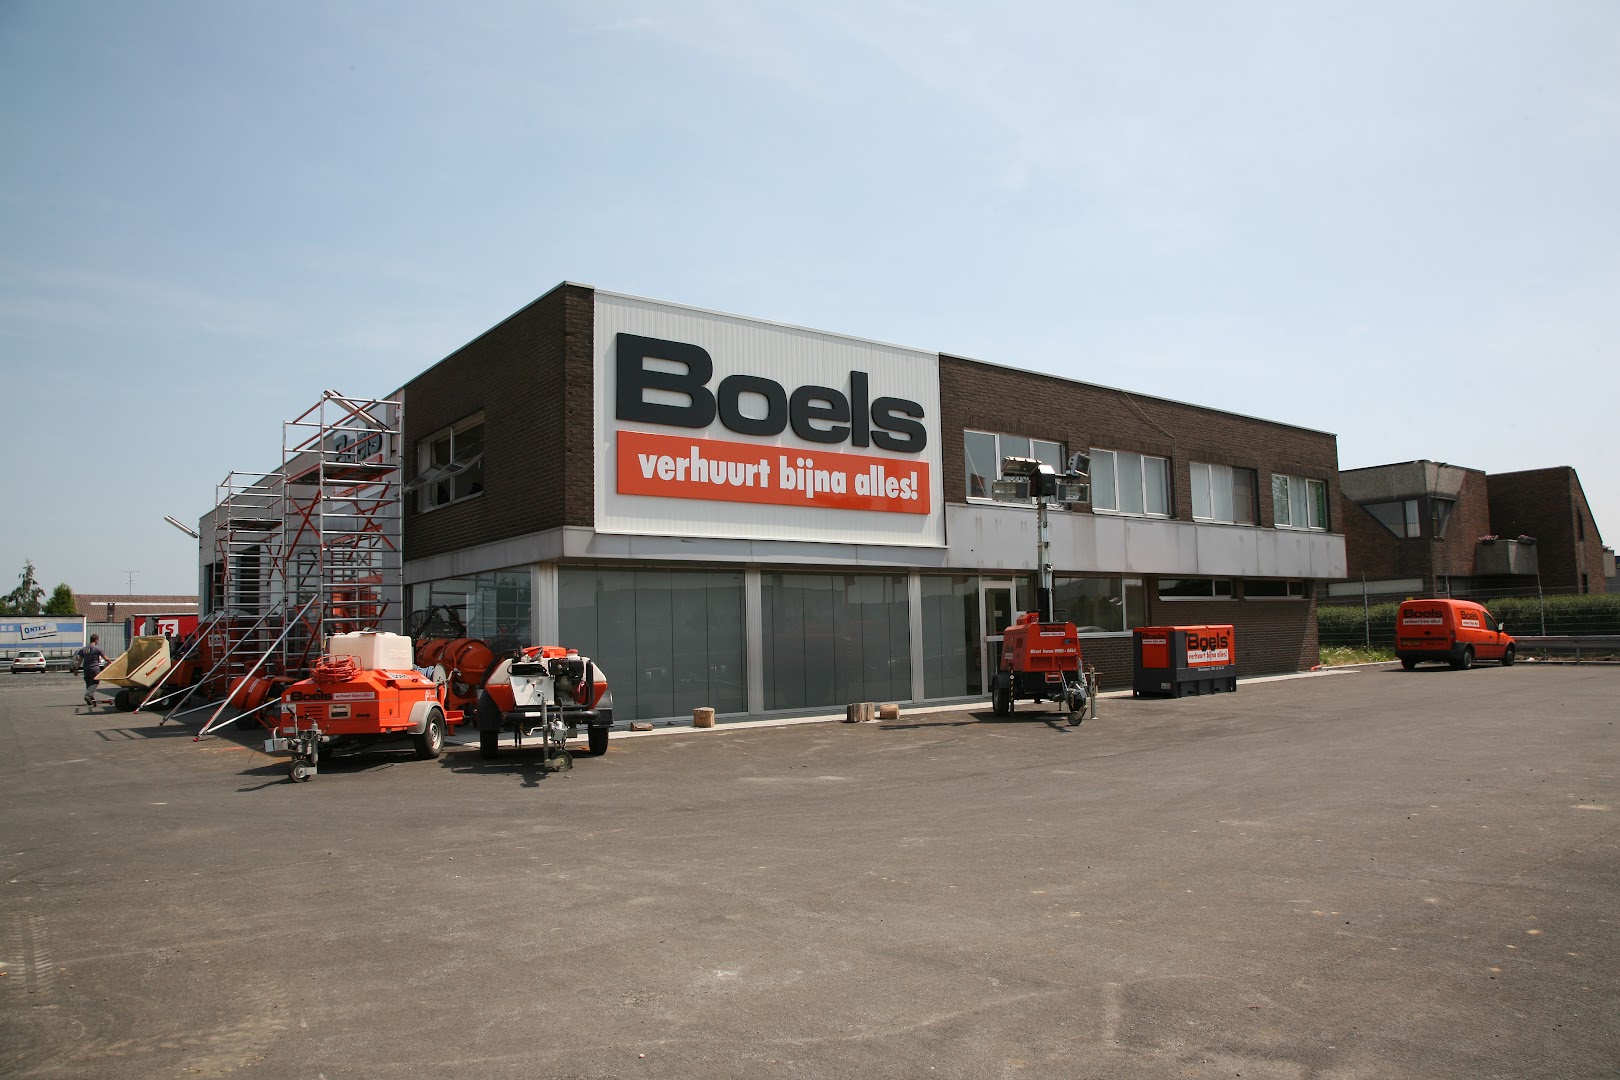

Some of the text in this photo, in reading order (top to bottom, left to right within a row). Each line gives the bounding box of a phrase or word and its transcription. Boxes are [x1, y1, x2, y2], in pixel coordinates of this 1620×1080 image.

[616, 332, 927, 453] Boels
[638, 446, 918, 501] verhuurt bijna alles!
[1404, 608, 1443, 619] Boels
[1460, 610, 1479, 620] Boels
[24, 625, 47, 634] ONTEX
[1187, 632, 1229, 650] Boels
[291, 690, 333, 702] Boels
